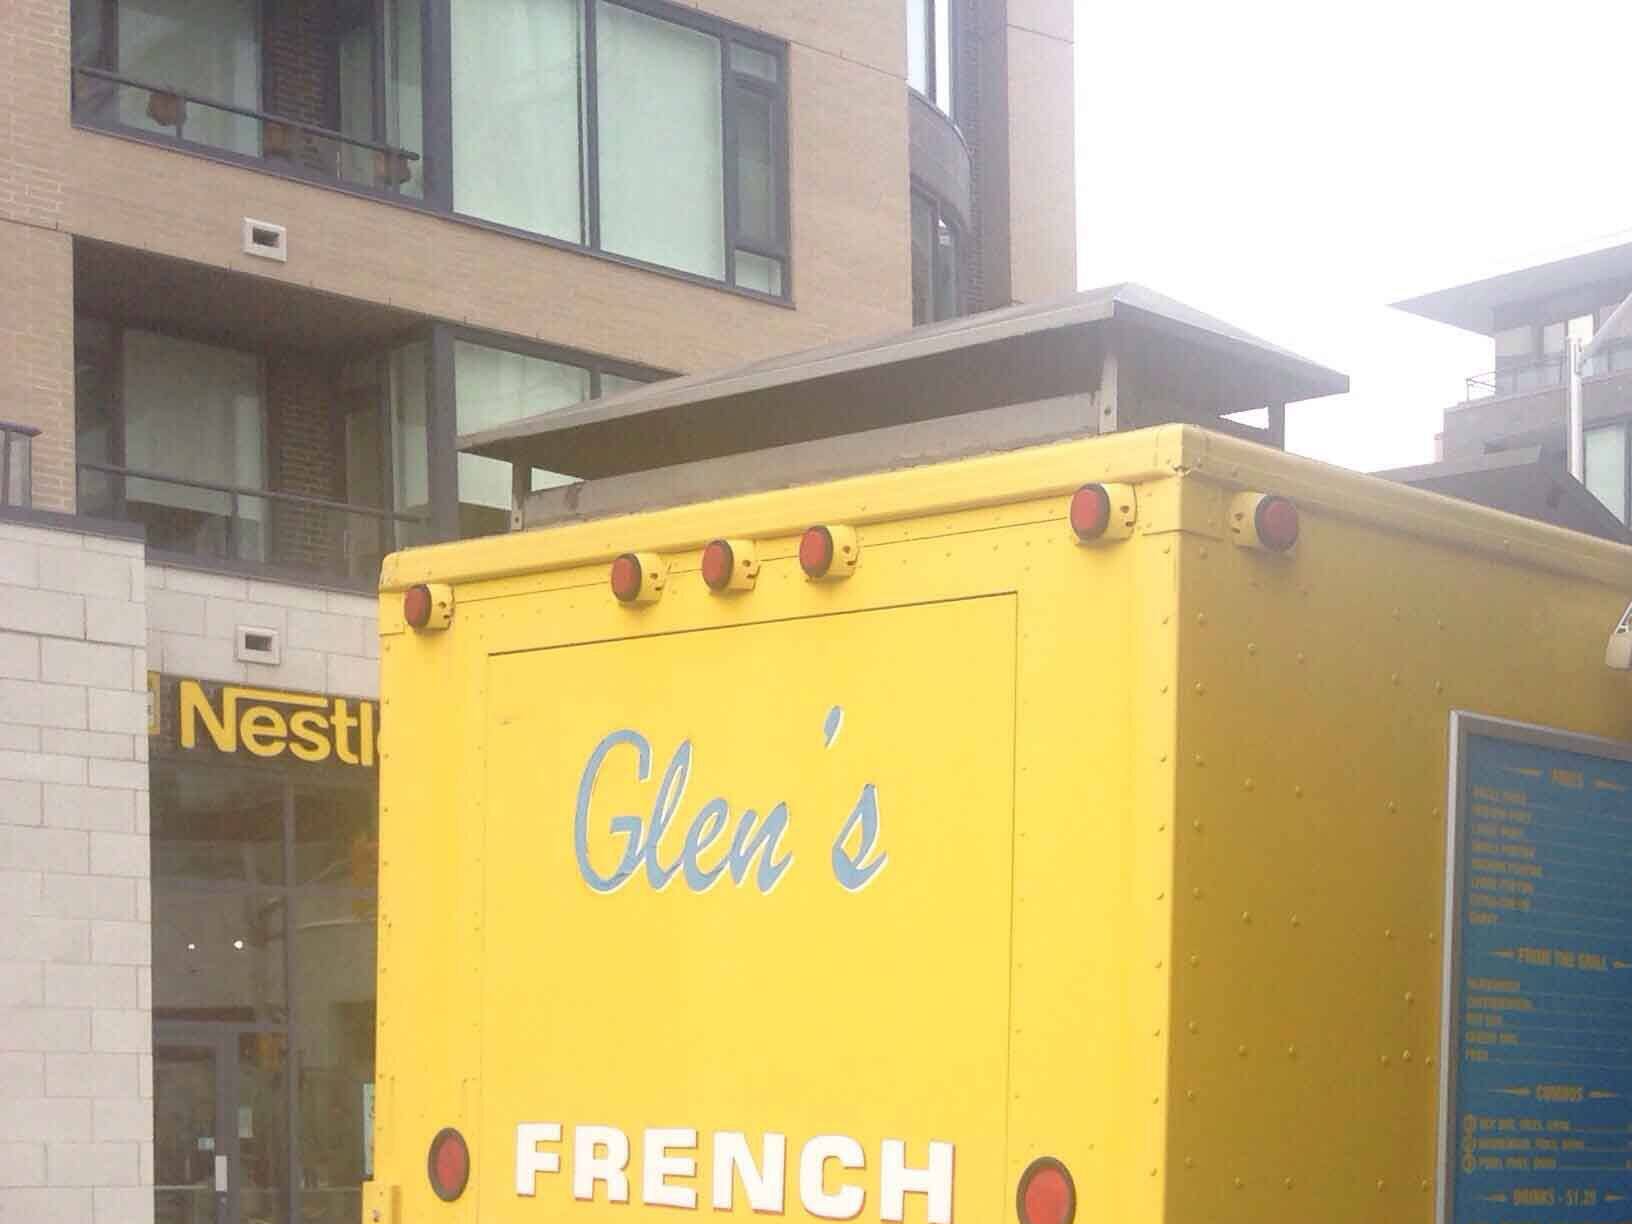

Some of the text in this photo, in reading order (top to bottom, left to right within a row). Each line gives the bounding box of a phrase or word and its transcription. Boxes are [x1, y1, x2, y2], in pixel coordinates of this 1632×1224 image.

[179, 678, 380, 767] Nestl
[573, 705, 888, 894] Glen's
[1519, 946, 1552, 967] FROM
